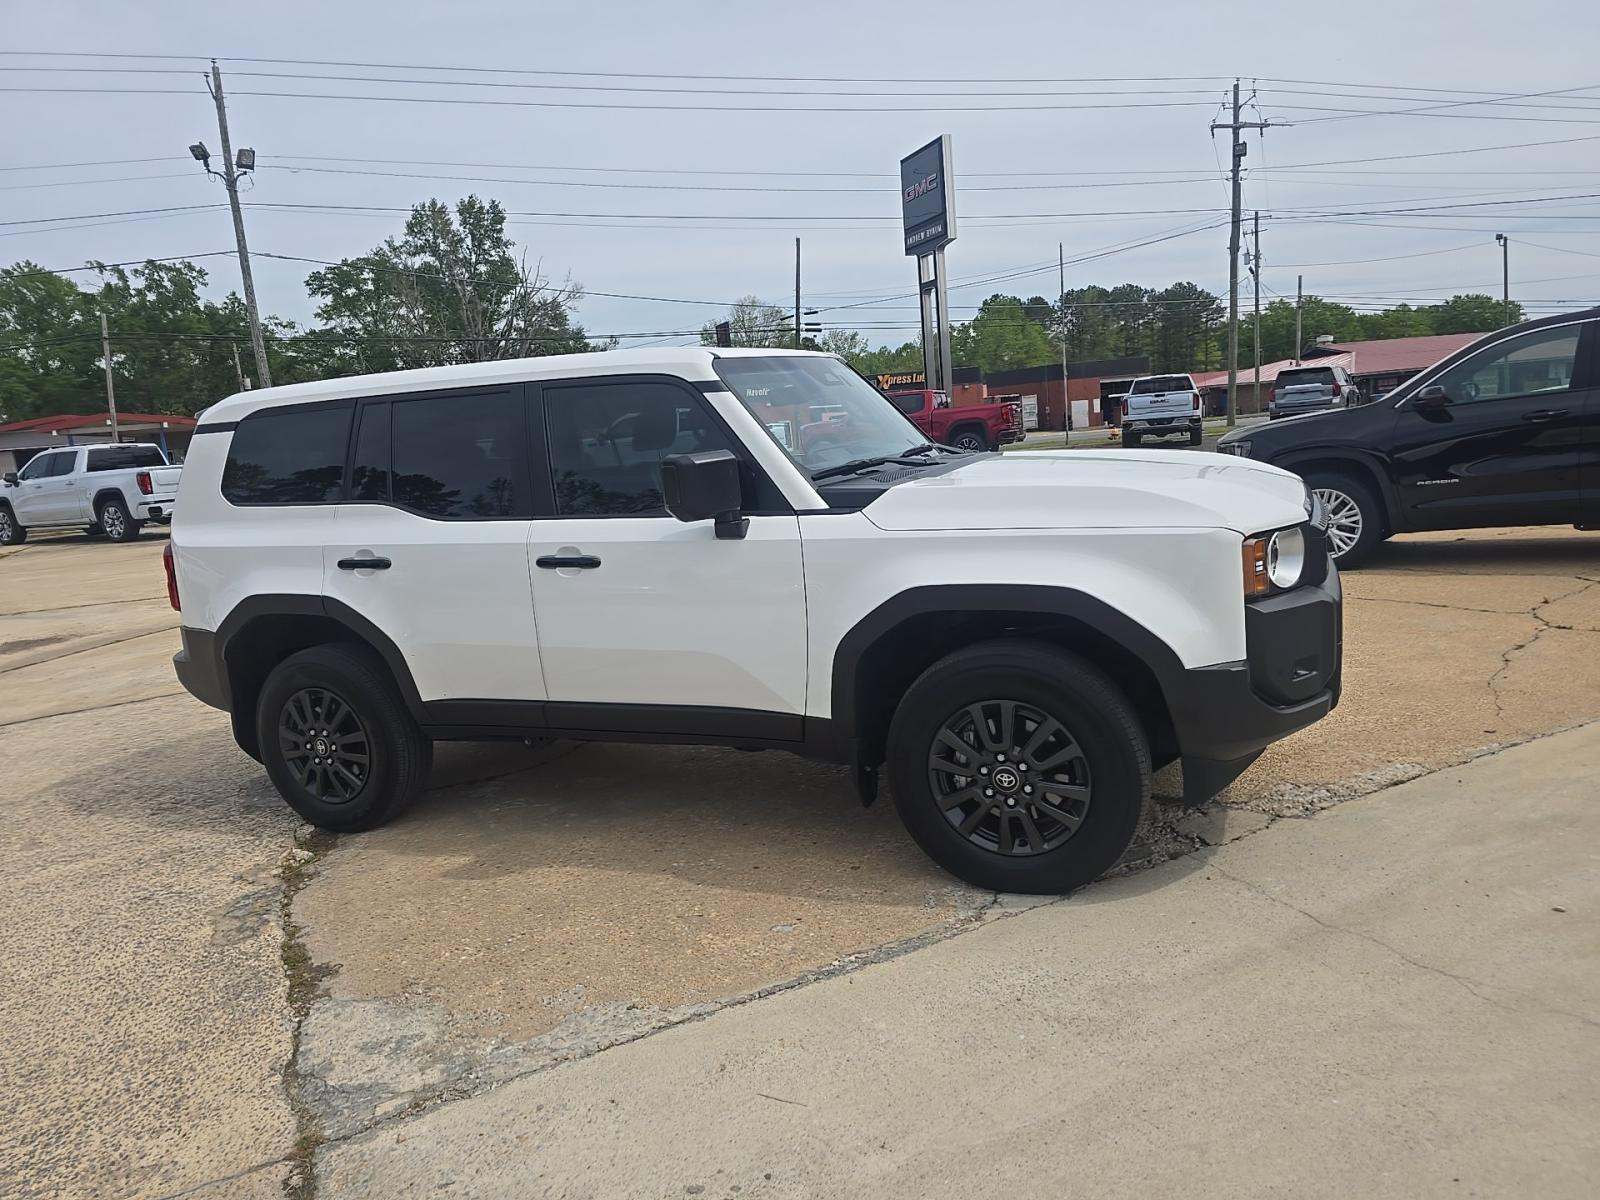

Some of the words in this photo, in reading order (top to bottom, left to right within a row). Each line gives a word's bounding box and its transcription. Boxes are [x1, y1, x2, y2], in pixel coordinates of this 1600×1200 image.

[904, 173, 937, 201] GMC
[877, 374, 912, 390] Xpress
[1416, 478, 1460, 486] ACADIA
